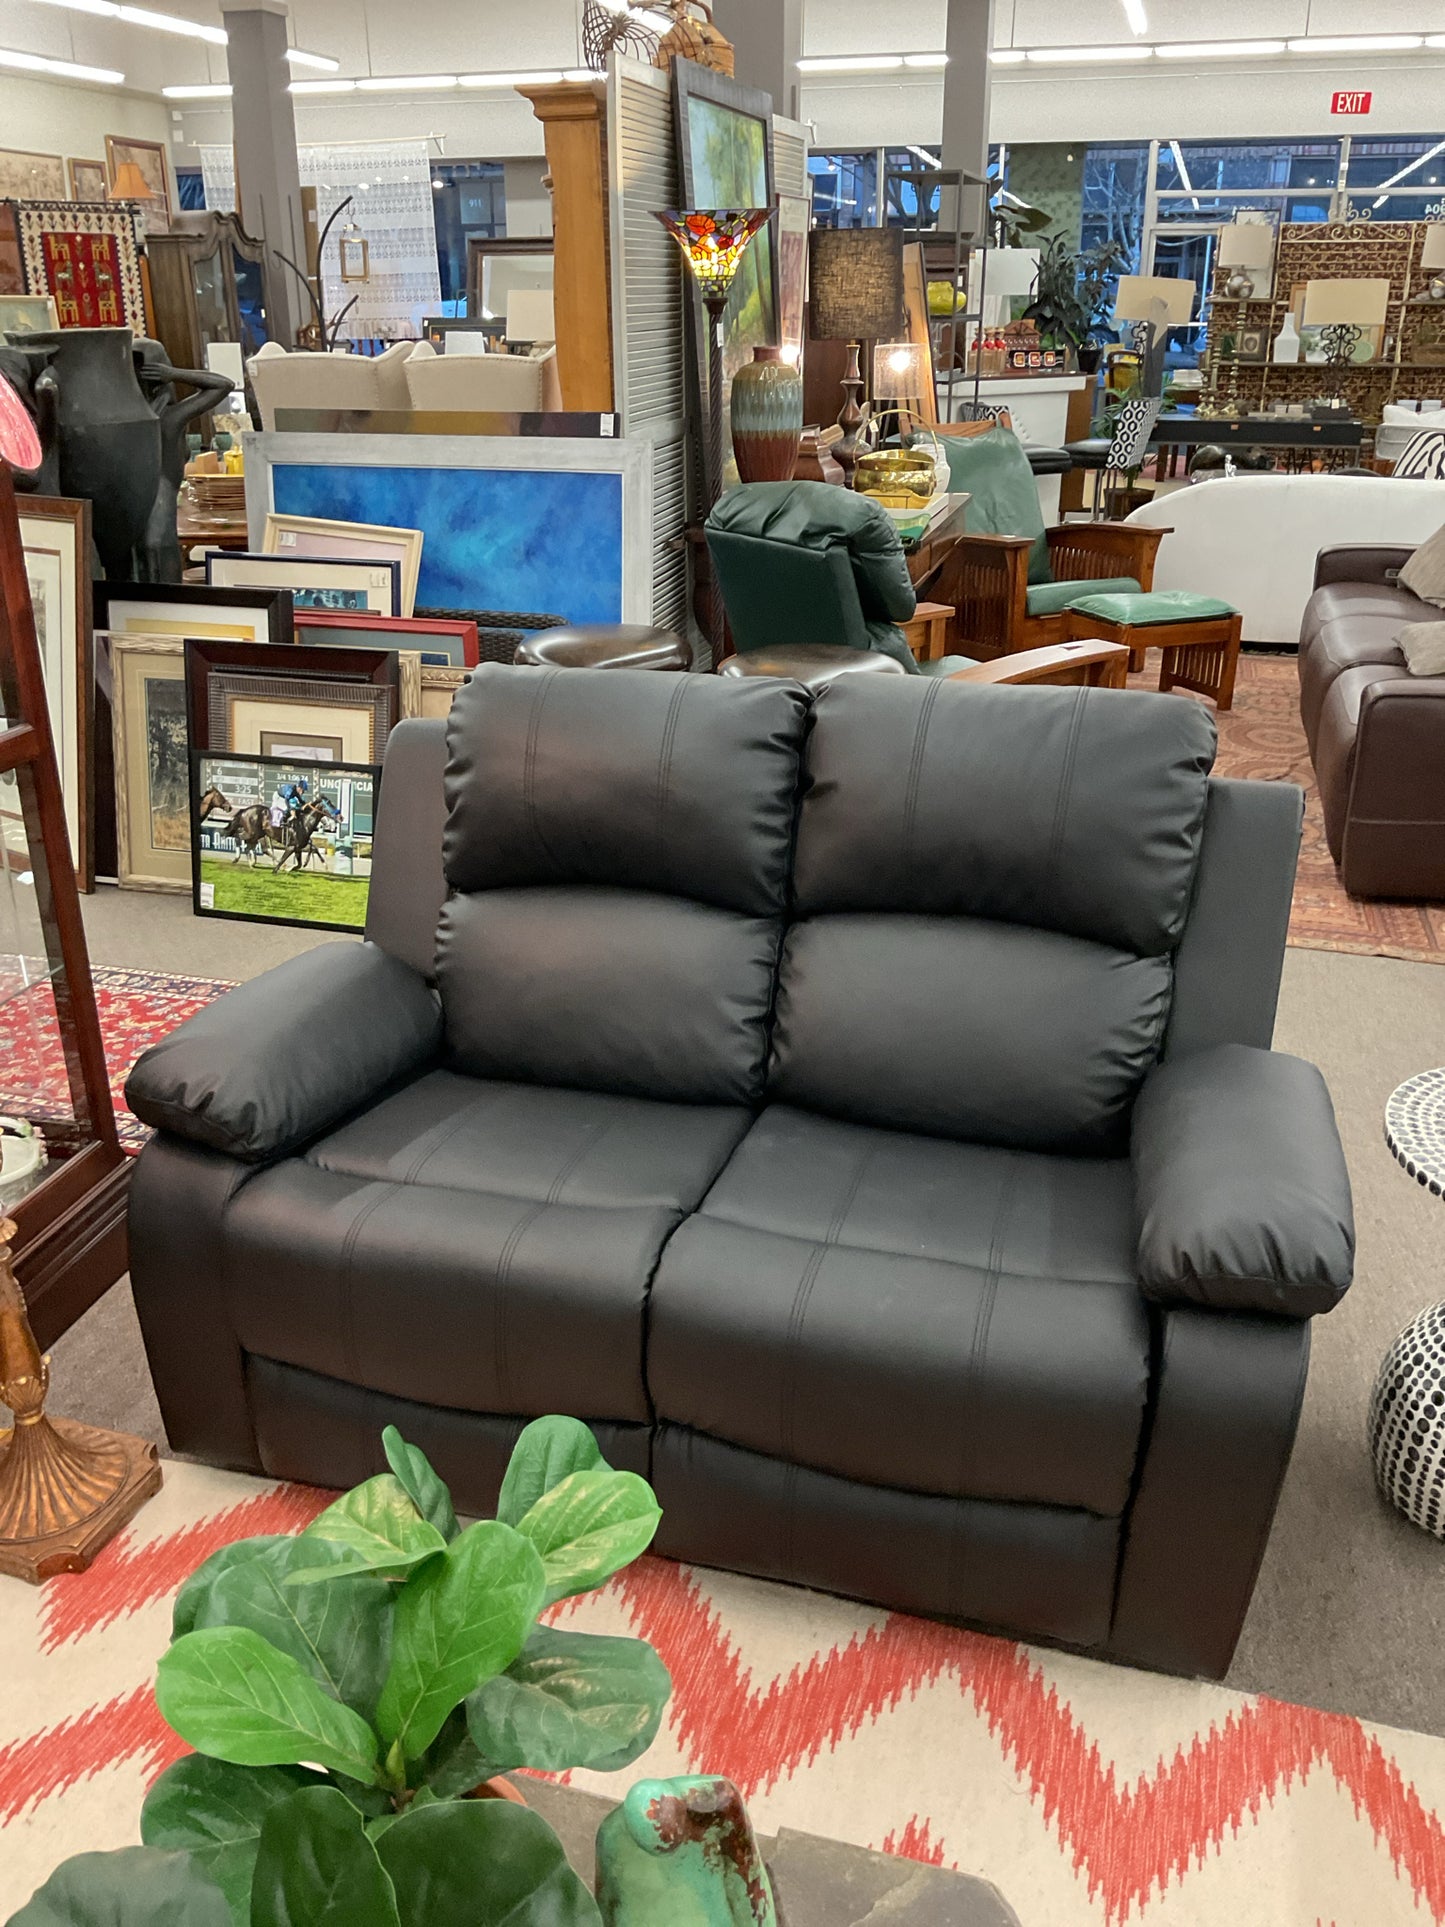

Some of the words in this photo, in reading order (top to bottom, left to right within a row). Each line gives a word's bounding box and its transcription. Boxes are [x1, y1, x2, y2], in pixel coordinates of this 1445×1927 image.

[1336, 93, 1366, 113] EXIT
[468, 198, 482, 208] 911
[216, 766, 223, 775] 6
